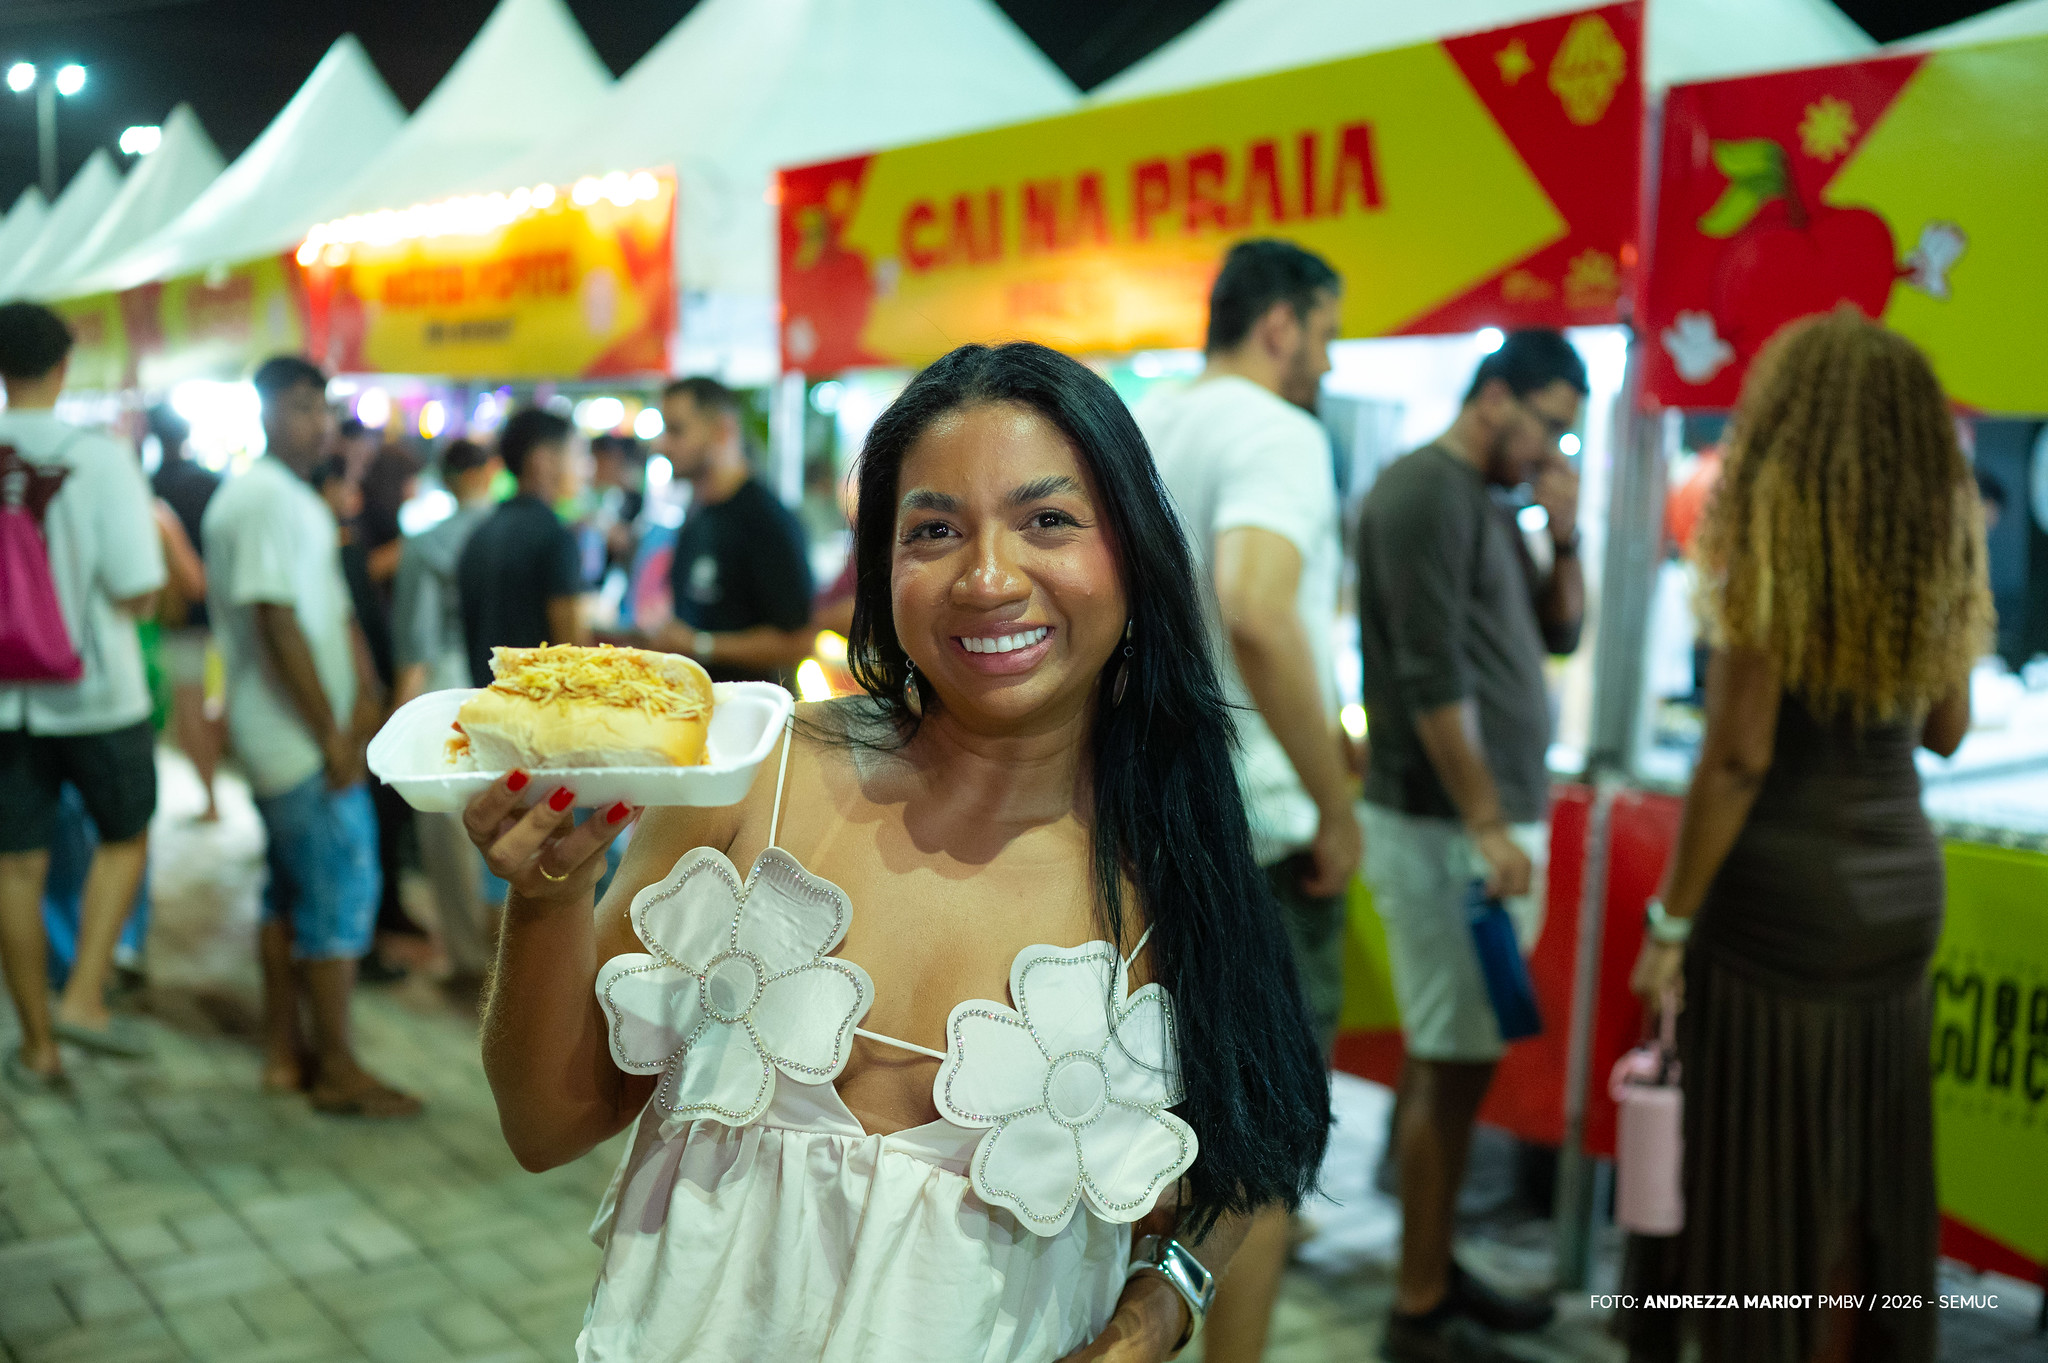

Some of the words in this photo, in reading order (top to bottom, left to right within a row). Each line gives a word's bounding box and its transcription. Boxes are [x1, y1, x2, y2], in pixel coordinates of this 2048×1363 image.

[900, 188, 1004, 274] CAI
[1019, 168, 1110, 258] NA
[1130, 119, 1385, 242] PRAIA
